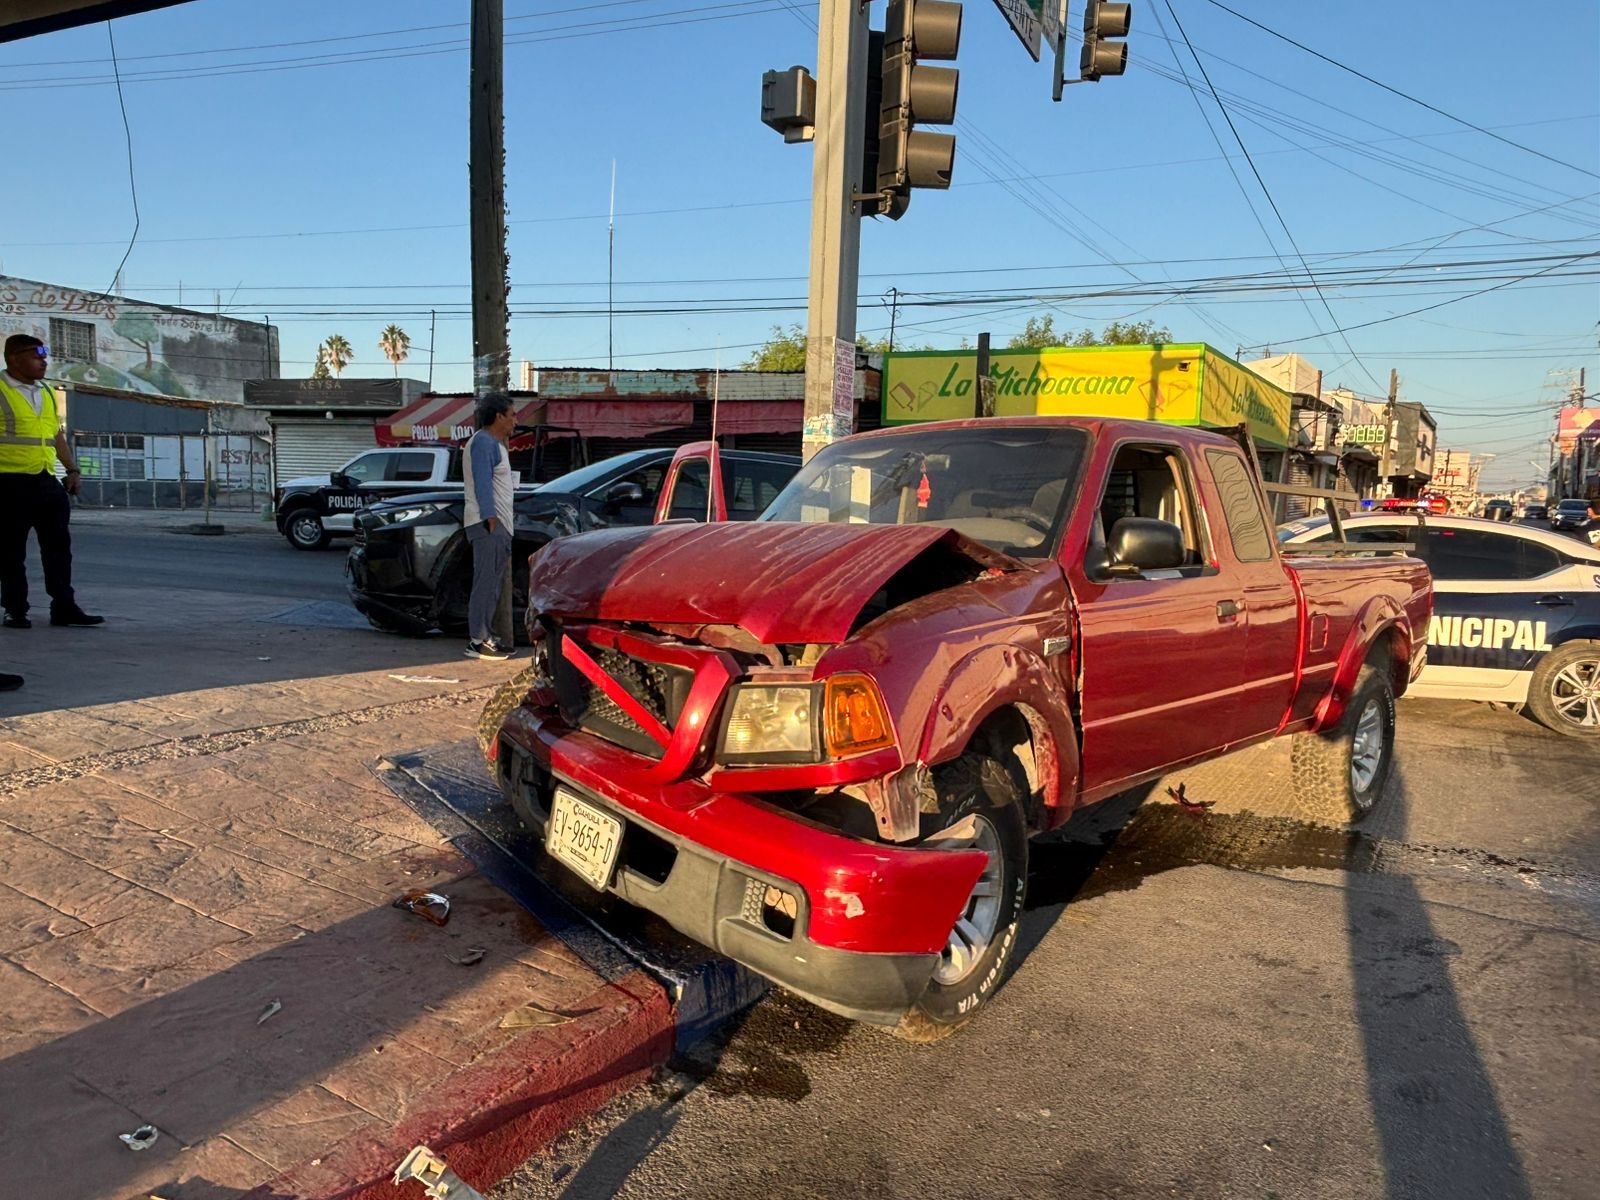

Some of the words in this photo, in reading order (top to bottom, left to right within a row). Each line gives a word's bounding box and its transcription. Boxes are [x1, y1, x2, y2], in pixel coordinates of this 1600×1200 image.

[938, 362, 972, 397] La
[989, 360, 1136, 397] Michoacana
[412, 425, 440, 440] POLLOS
[328, 493, 364, 509] POLICÍA
